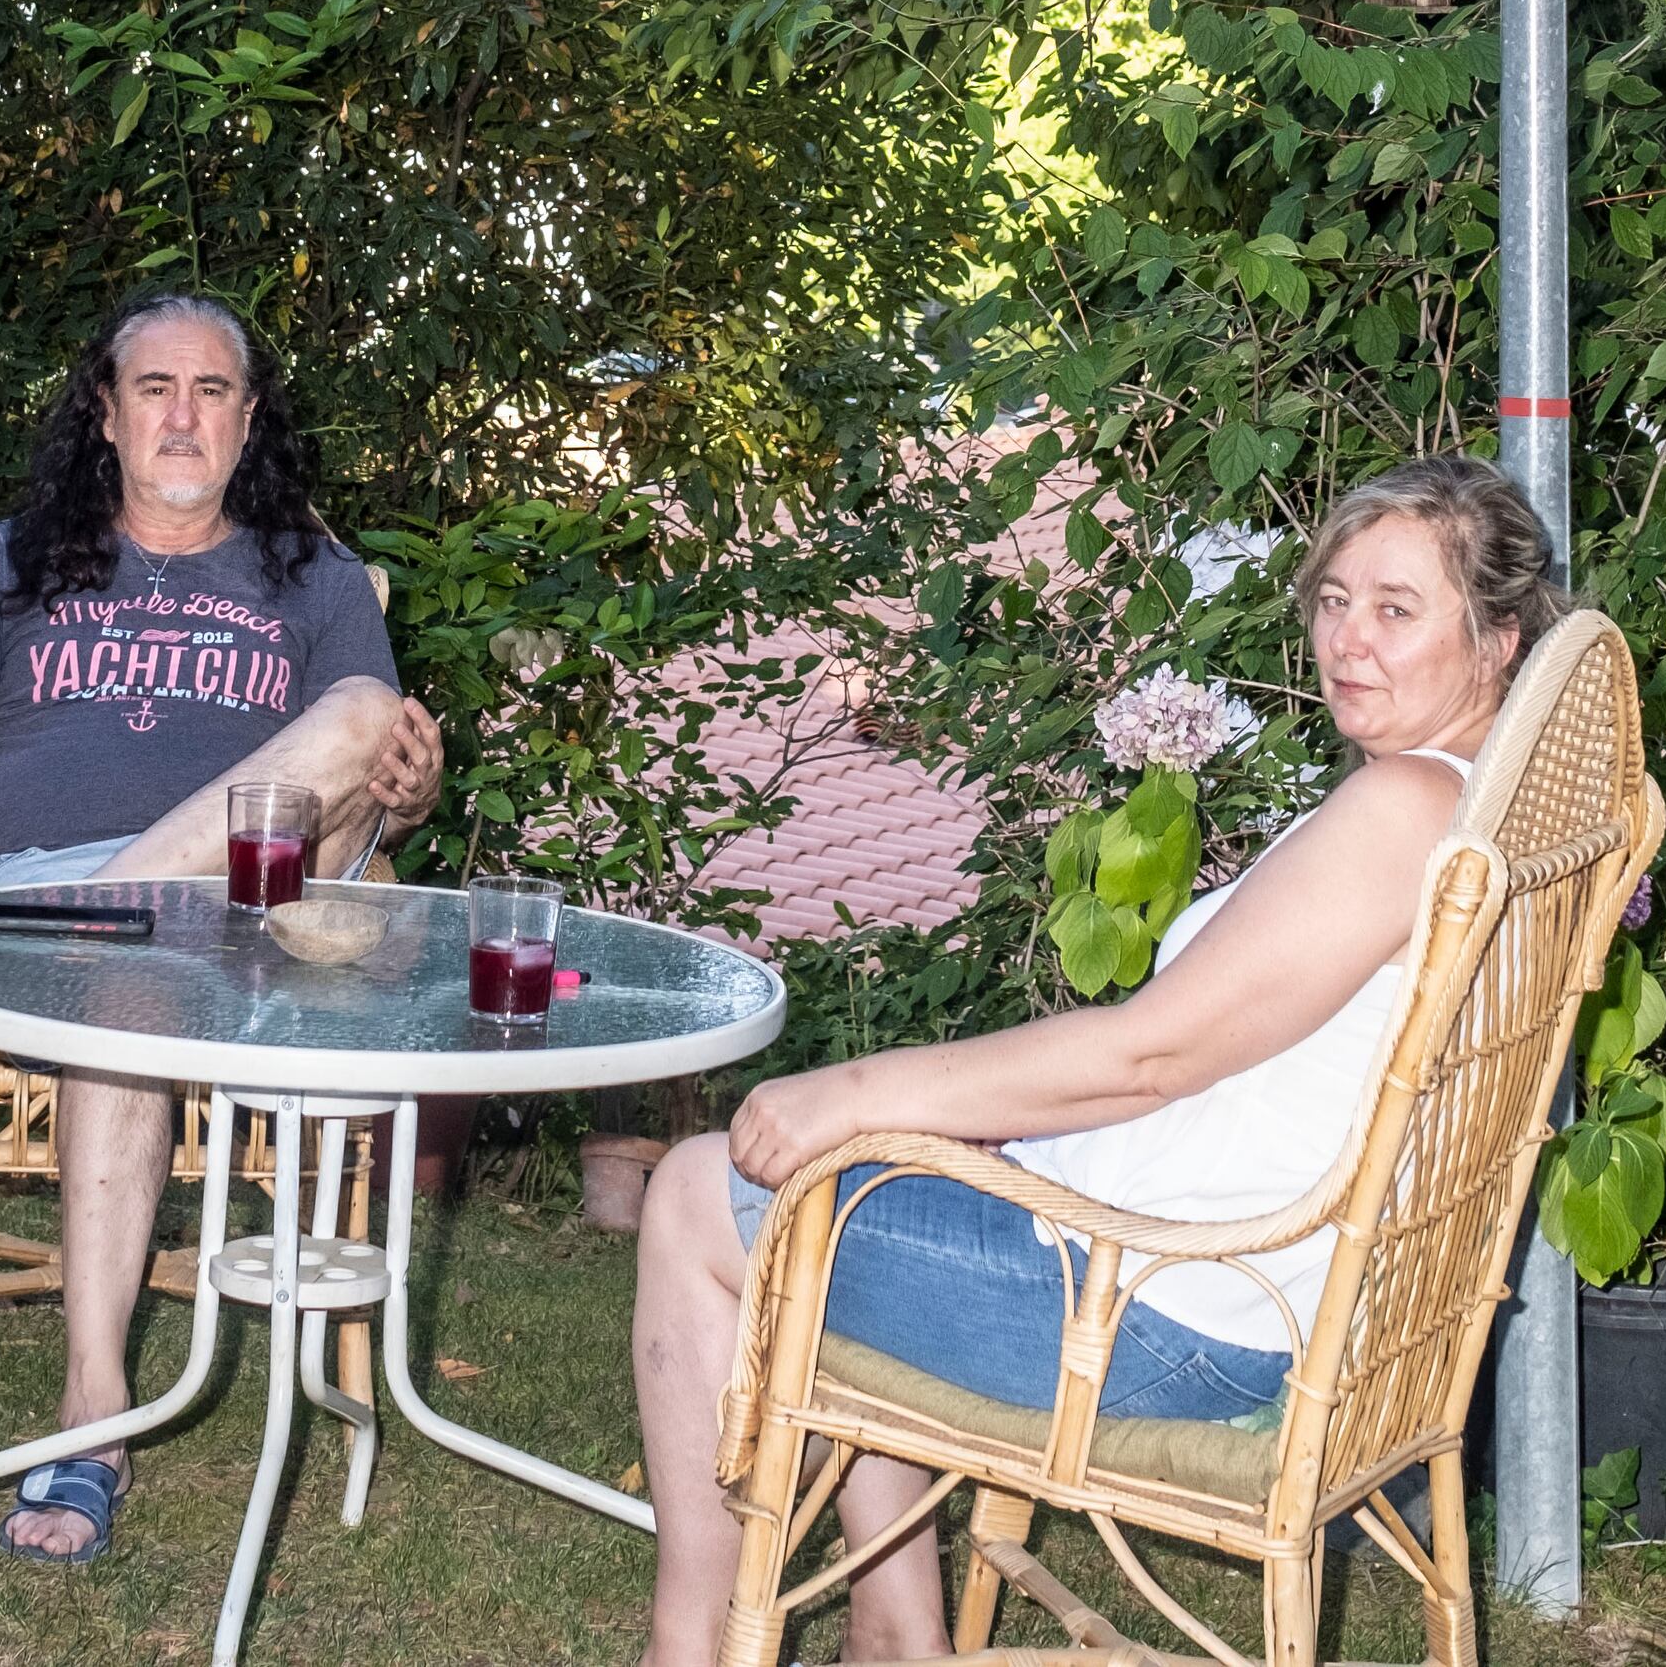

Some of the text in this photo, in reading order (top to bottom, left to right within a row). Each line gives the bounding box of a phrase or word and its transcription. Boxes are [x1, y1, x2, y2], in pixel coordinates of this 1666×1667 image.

[101, 627, 234, 644] EST 2012
[183, 592, 282, 642] Beach
[30, 639, 189, 703] YACHT
